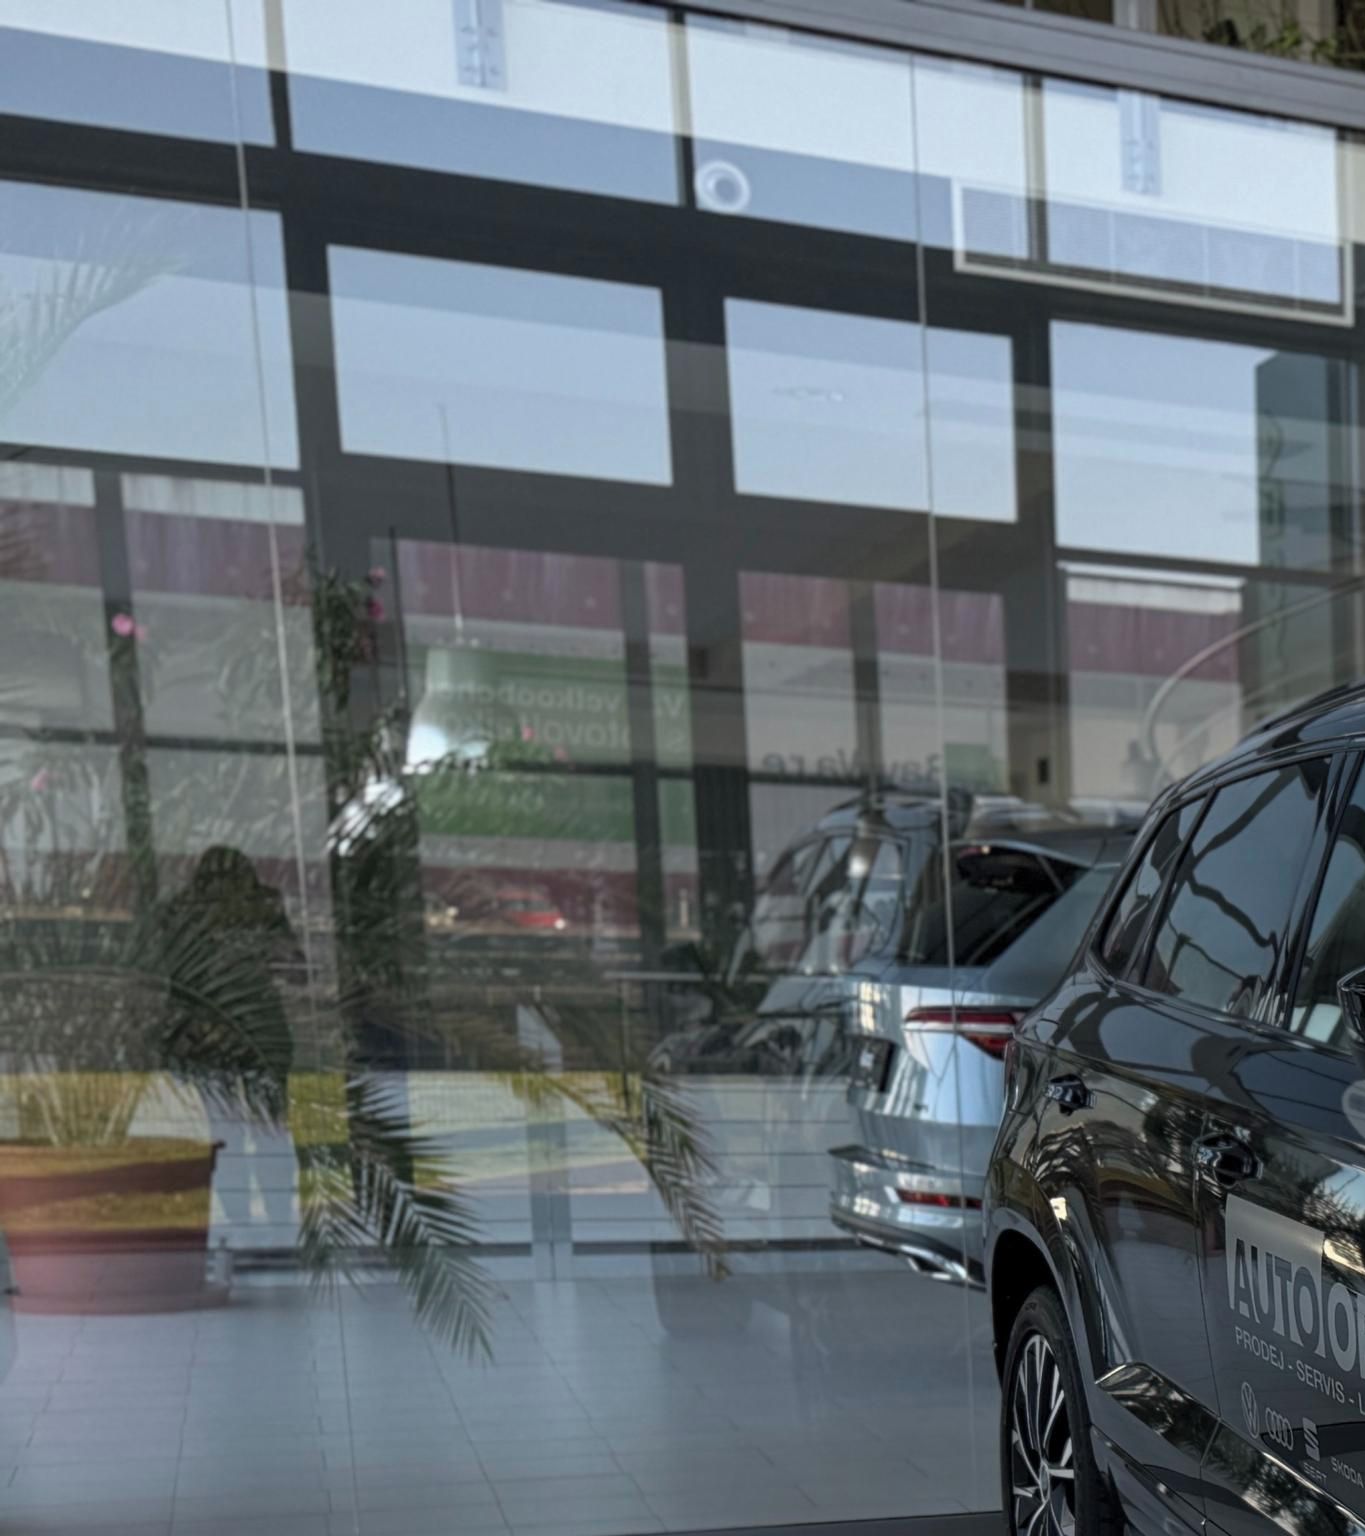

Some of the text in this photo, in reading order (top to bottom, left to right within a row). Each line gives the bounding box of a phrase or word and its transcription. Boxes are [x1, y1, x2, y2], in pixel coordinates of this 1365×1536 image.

[1234, 1238, 1321, 1350] AUTO
[1235, 1326, 1285, 1370] PRODEJ
[1296, 1360, 1345, 1404] SERVIS
